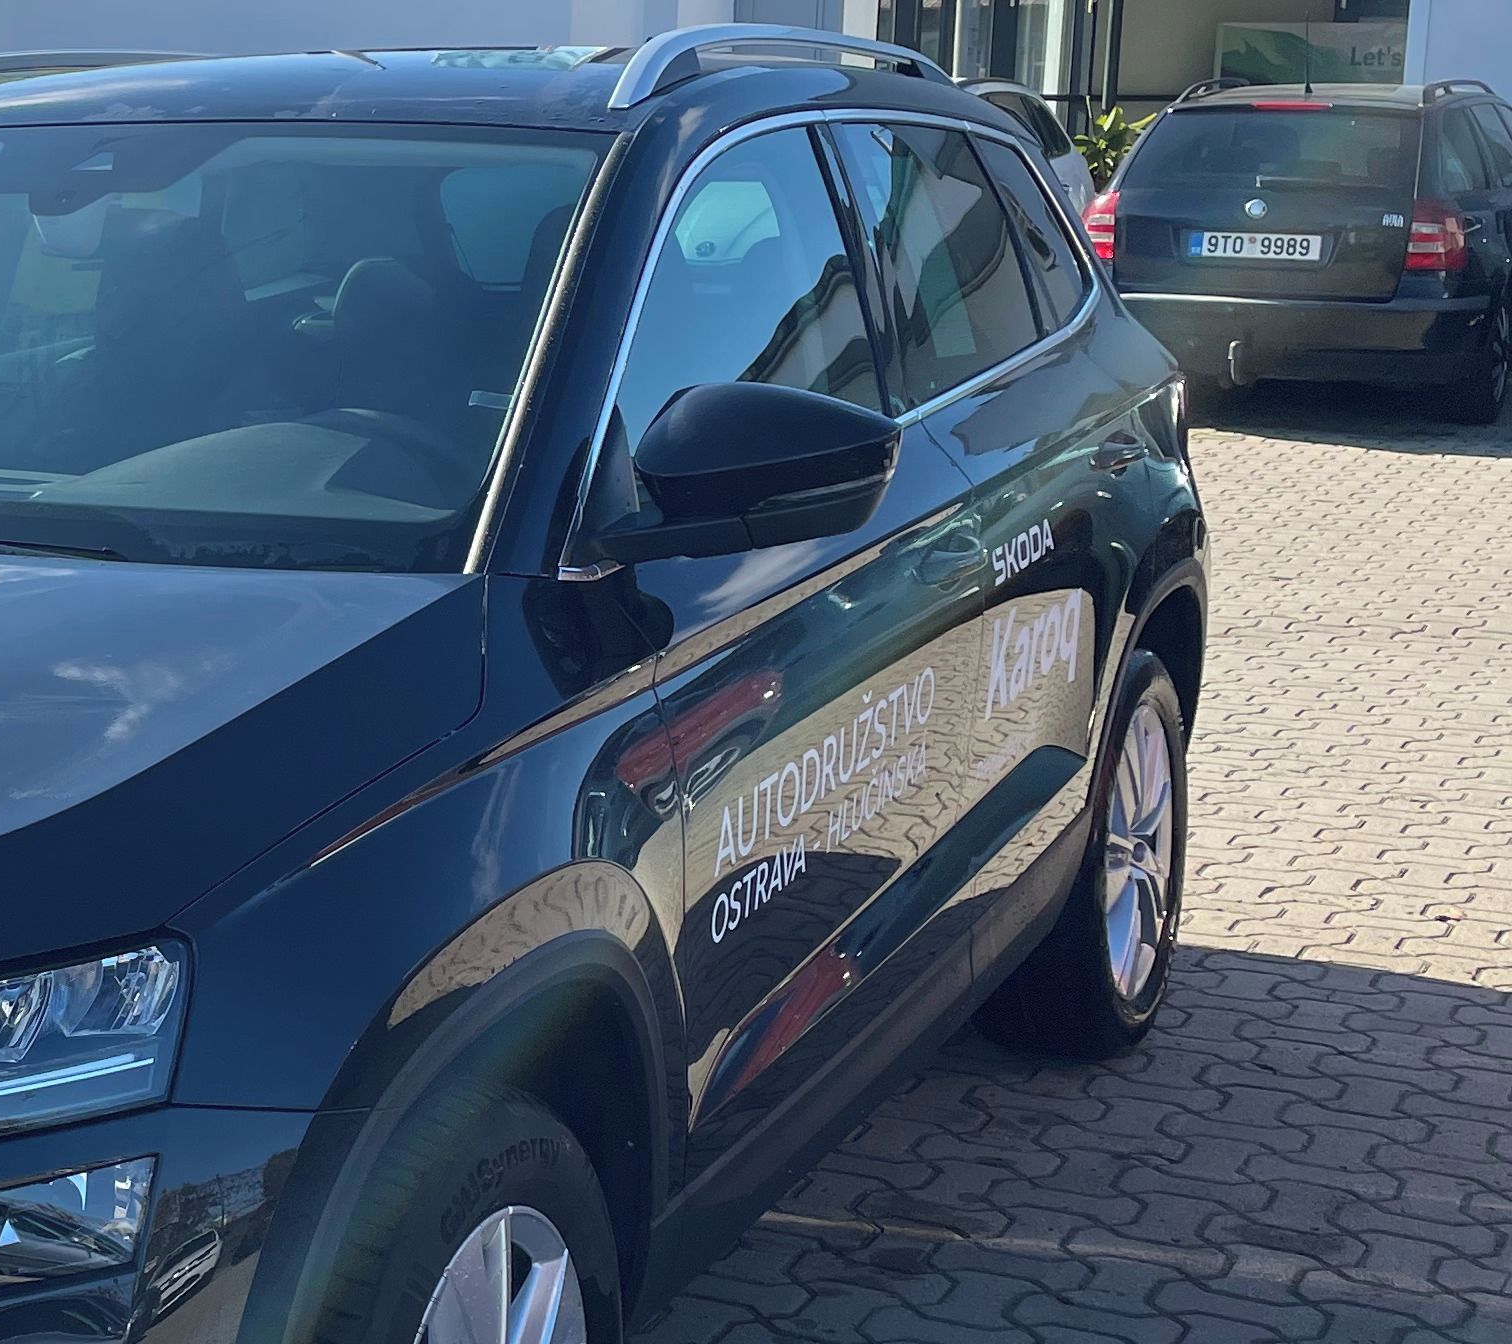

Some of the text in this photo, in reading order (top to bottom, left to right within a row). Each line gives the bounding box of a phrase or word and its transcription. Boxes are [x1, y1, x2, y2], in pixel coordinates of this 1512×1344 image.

[1349, 45, 1402, 67] Let's
[1260, 236, 1311, 257] 9989
[985, 587, 1083, 721] Karoq
[714, 666, 935, 877] AUTODRUŽSTVO
[711, 834, 806, 944] OSTRAVA
